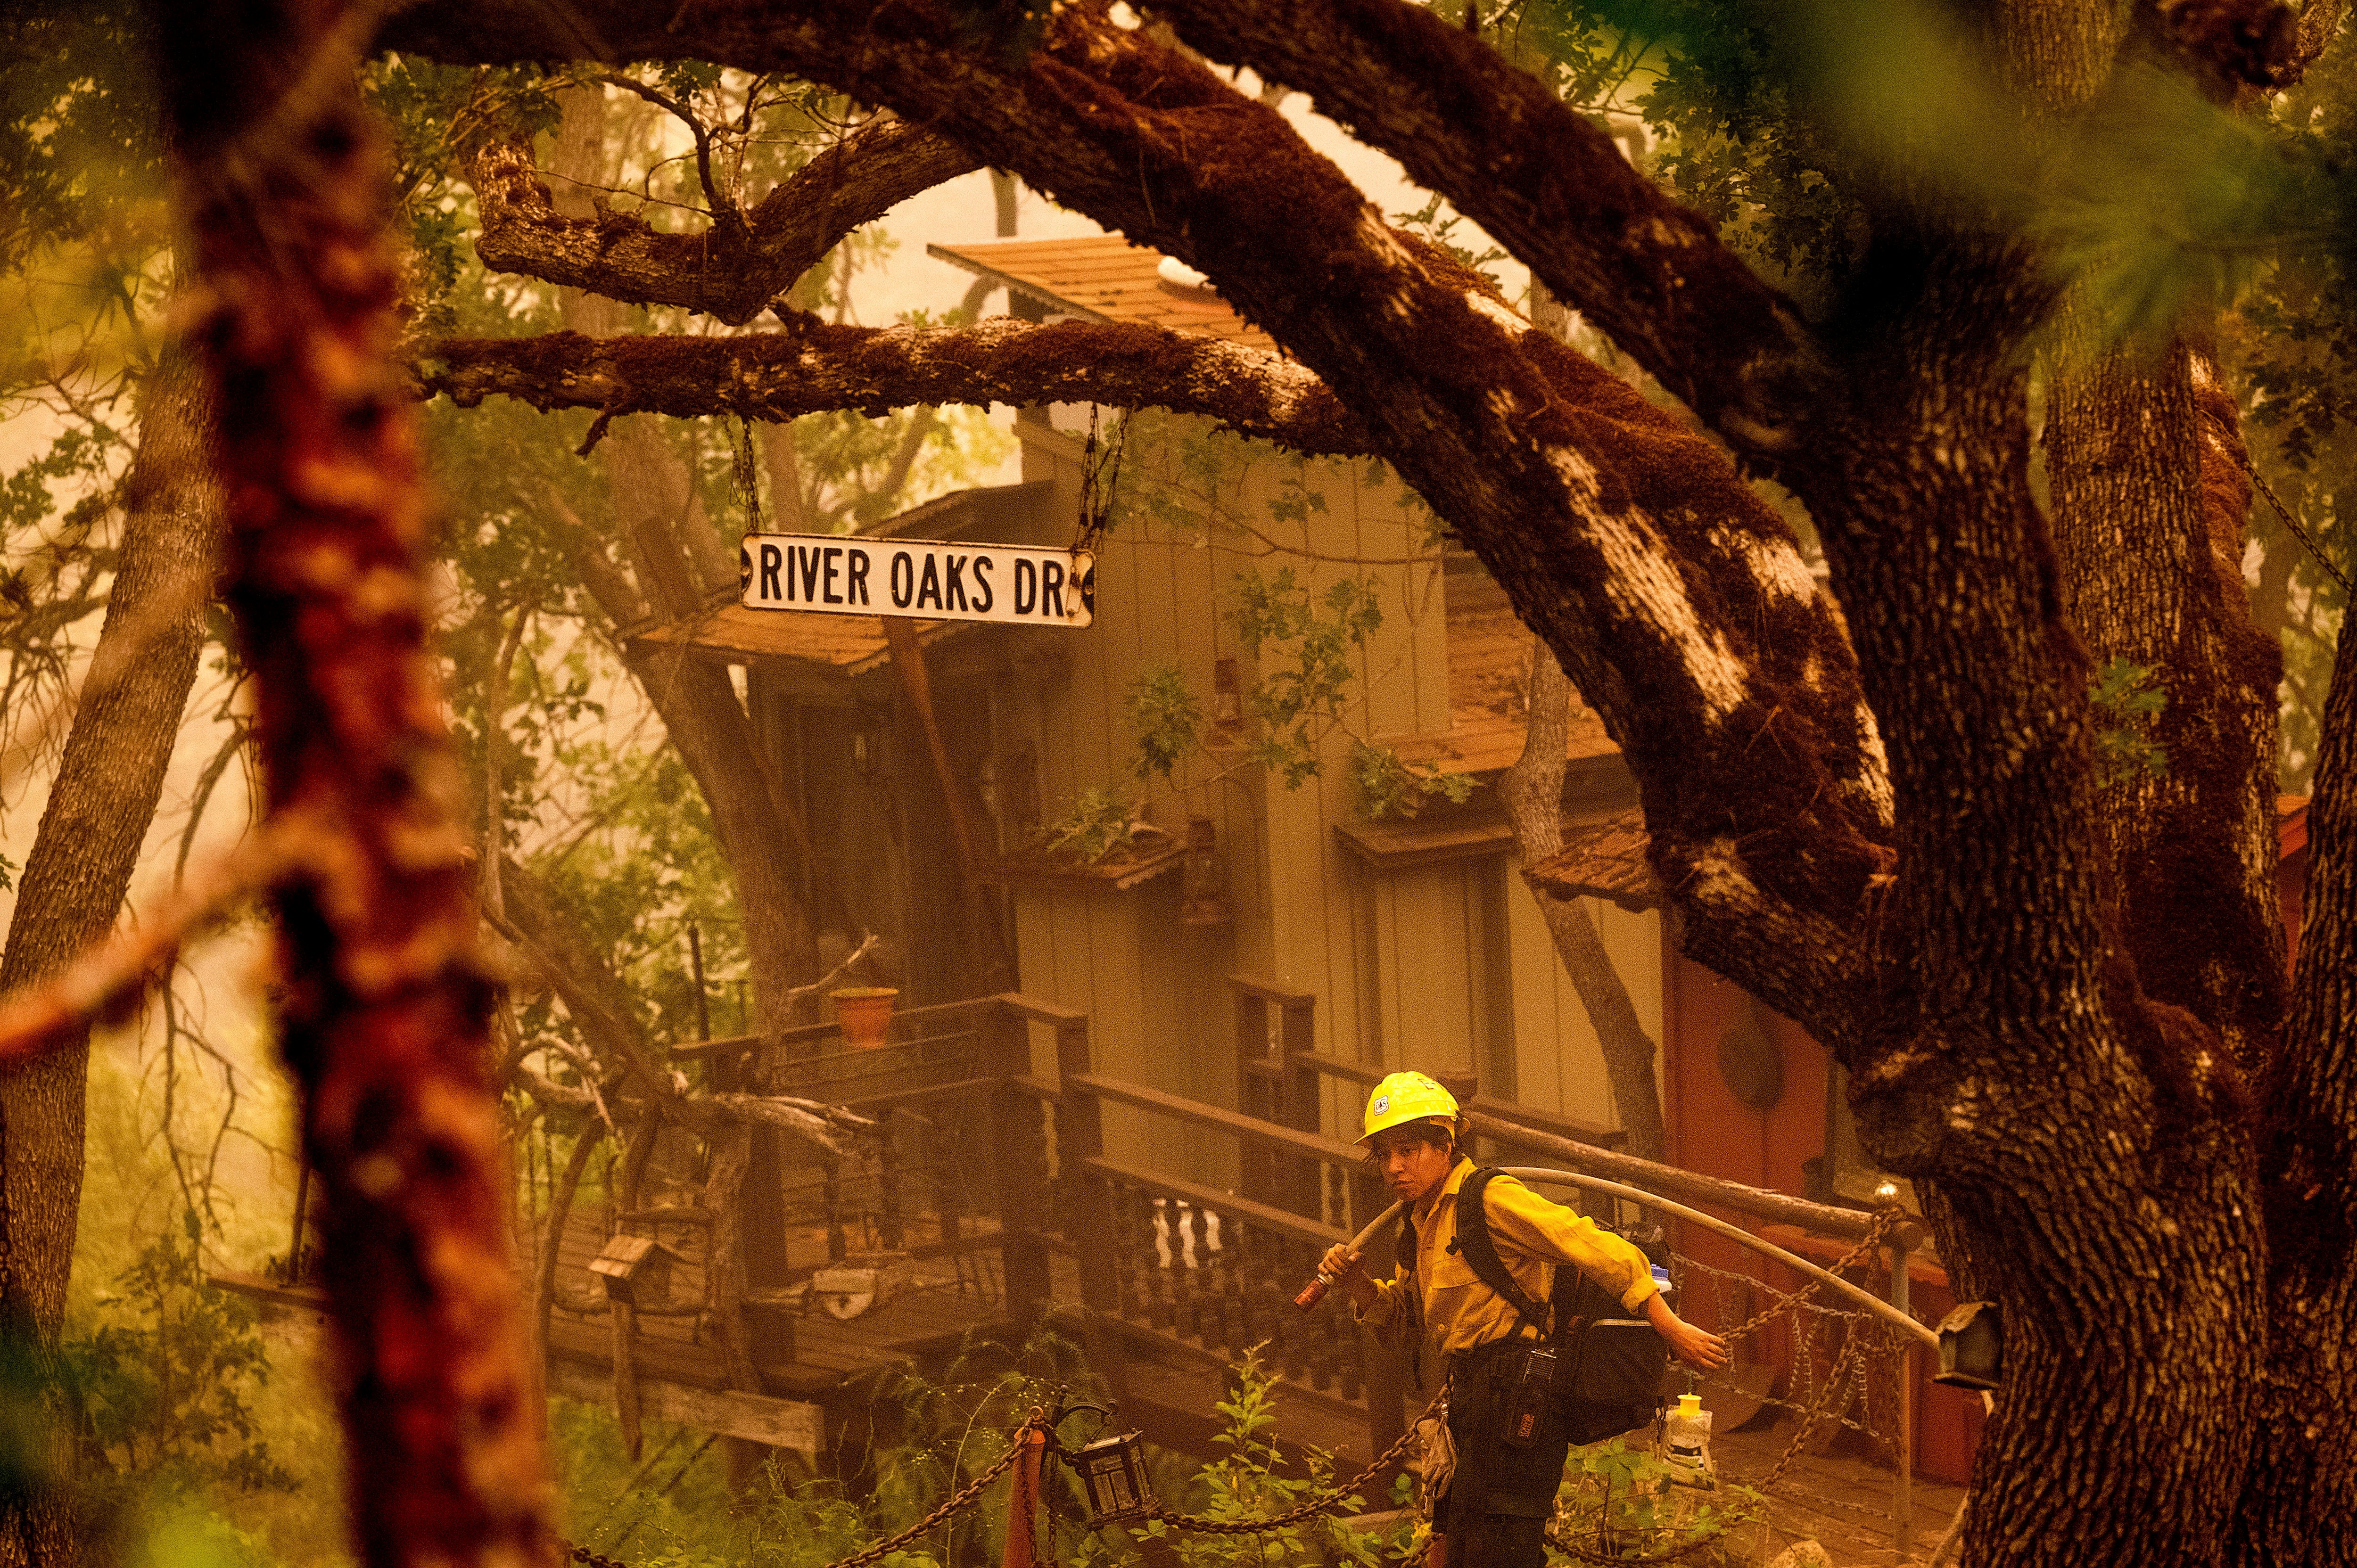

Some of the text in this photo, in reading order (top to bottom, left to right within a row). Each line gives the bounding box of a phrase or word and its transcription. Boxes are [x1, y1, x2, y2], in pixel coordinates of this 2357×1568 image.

[760, 543, 1065, 617] RIVER OAKS DR
